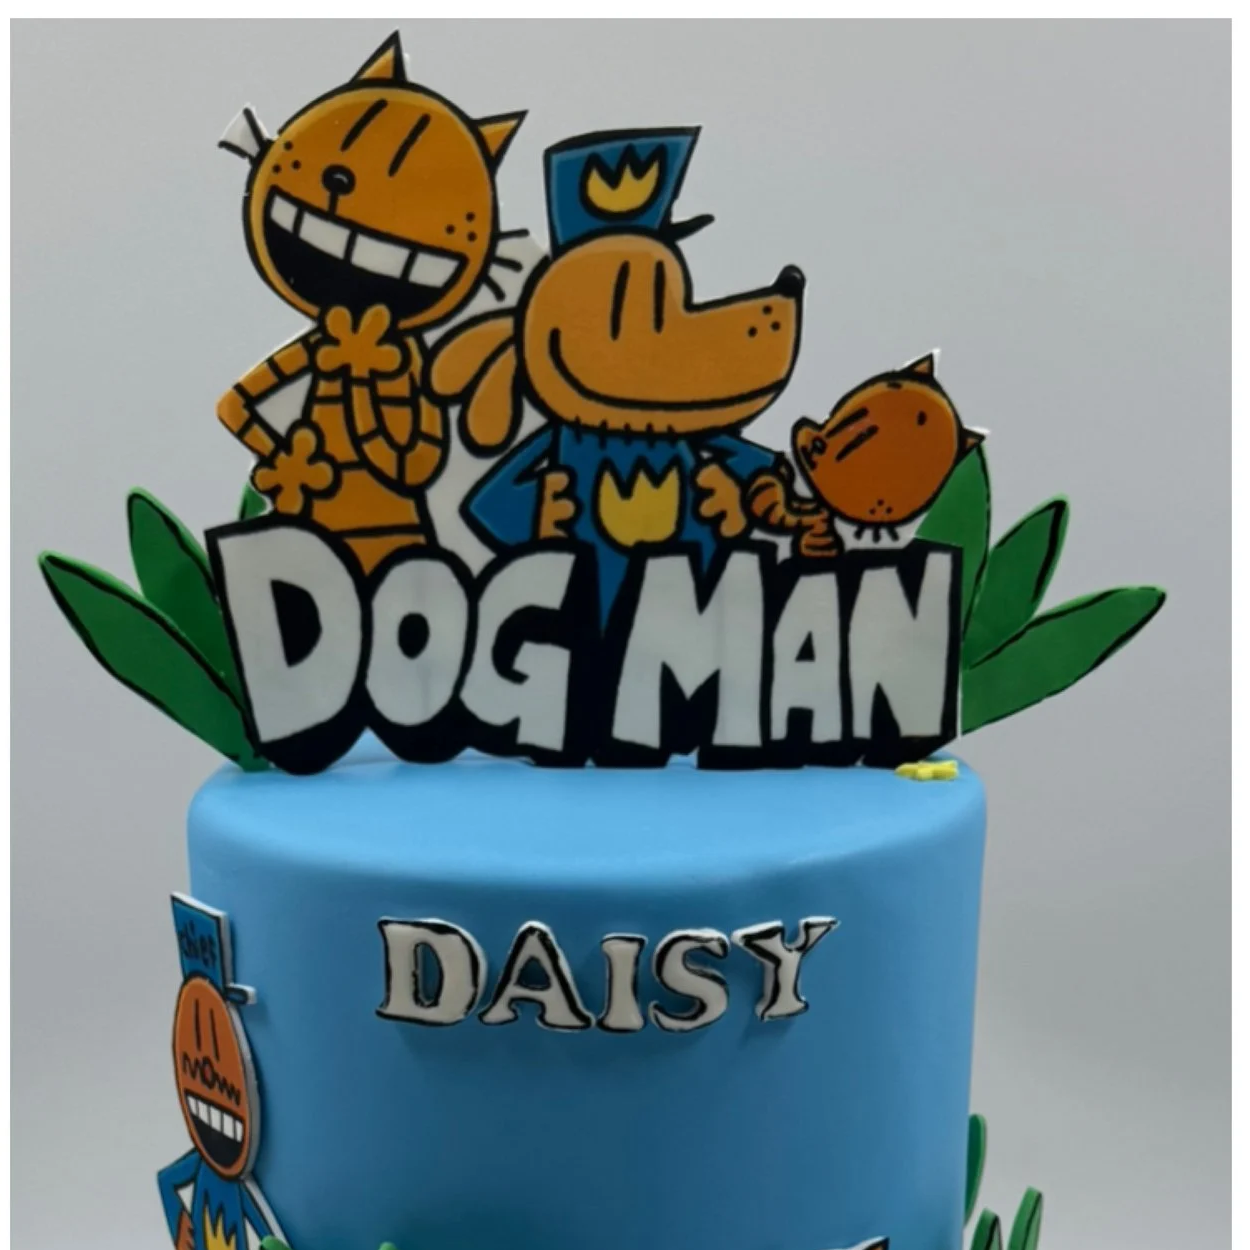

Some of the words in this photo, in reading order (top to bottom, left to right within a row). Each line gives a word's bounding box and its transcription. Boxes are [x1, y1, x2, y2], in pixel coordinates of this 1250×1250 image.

[215, 525, 576, 752] DOG
[611, 547, 953, 748] MAN
[374, 916, 841, 1032] DAISY
